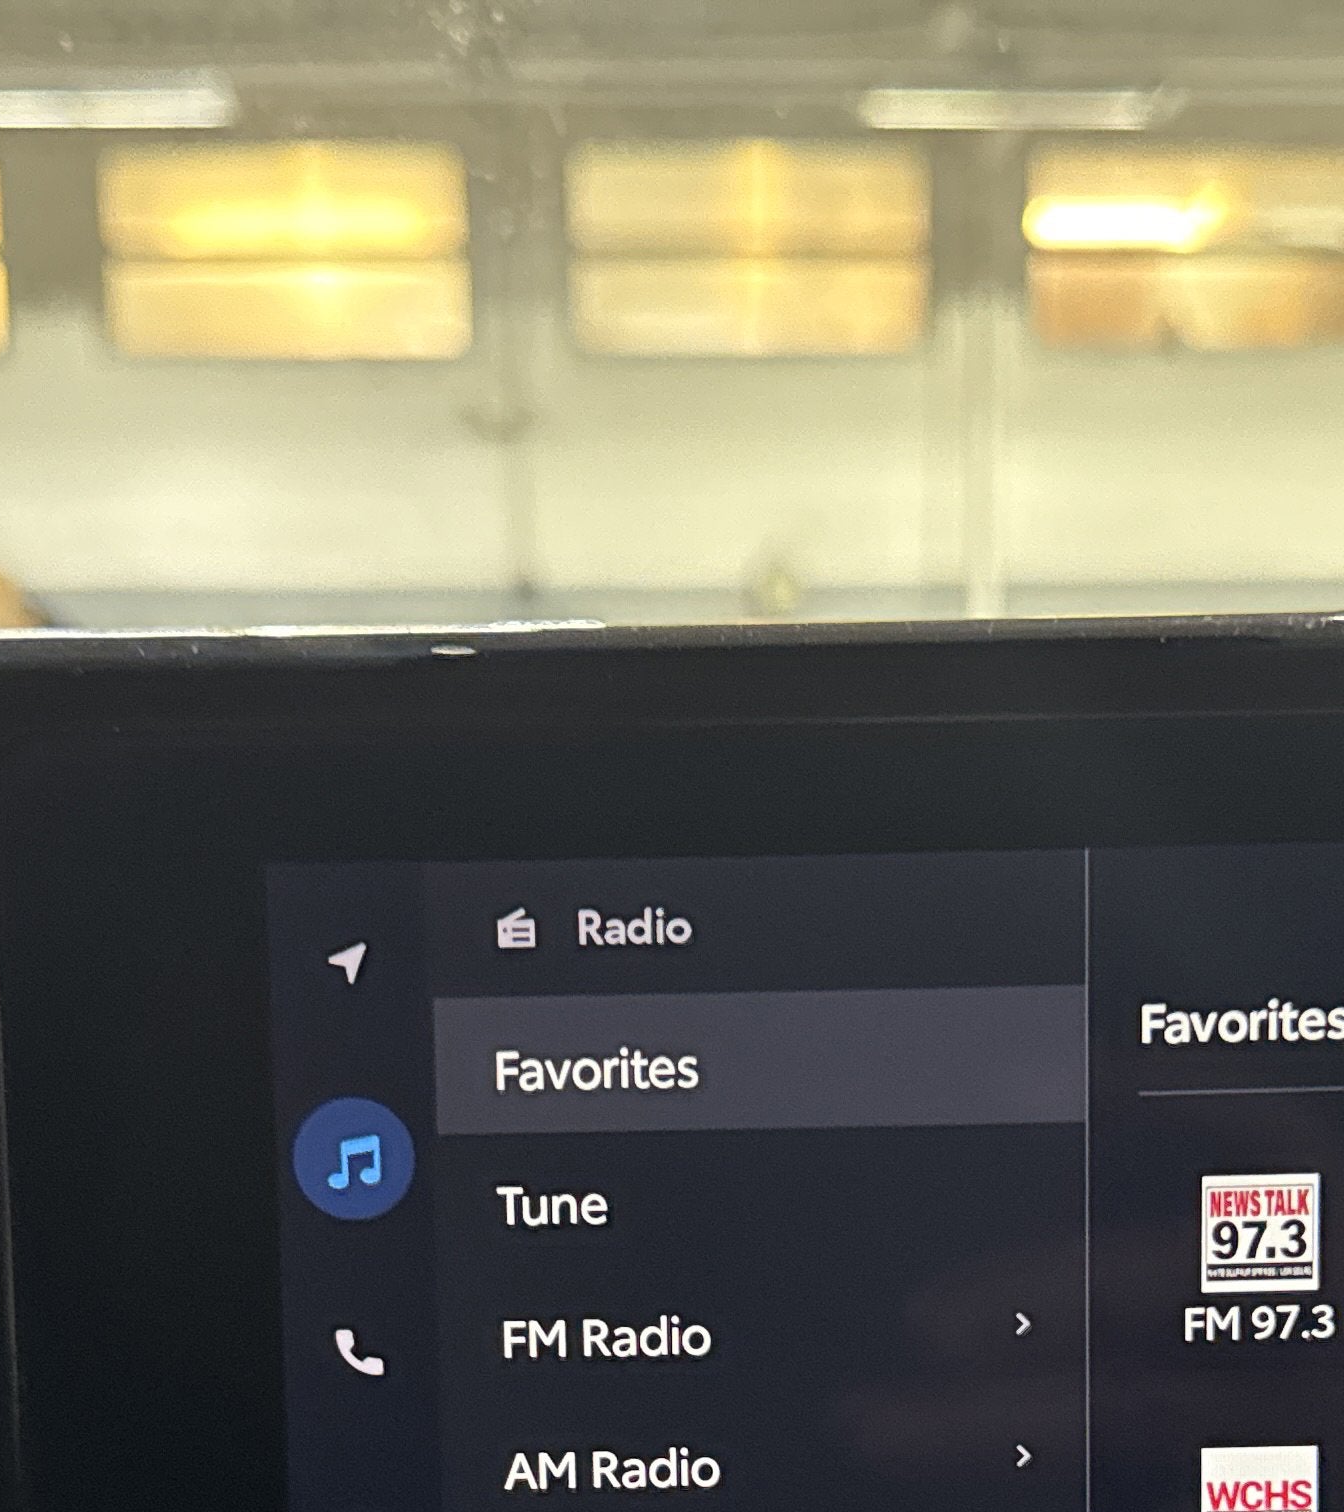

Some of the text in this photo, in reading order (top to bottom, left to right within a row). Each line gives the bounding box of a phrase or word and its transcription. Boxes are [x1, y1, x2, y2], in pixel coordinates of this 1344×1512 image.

[577, 906, 693, 946] Radio
[495, 1046, 699, 1092] Favorites
[495, 1186, 608, 1227] Tune
[1209, 1188, 1311, 1217] NEWS TALK
[1212, 1219, 1307, 1260] 97.3
[503, 1314, 712, 1359] FM Radio
[1184, 1304, 1335, 1342] FM 97.3
[503, 1446, 721, 1491] AM Radio
[1206, 1480, 1313, 1511] WCHS
